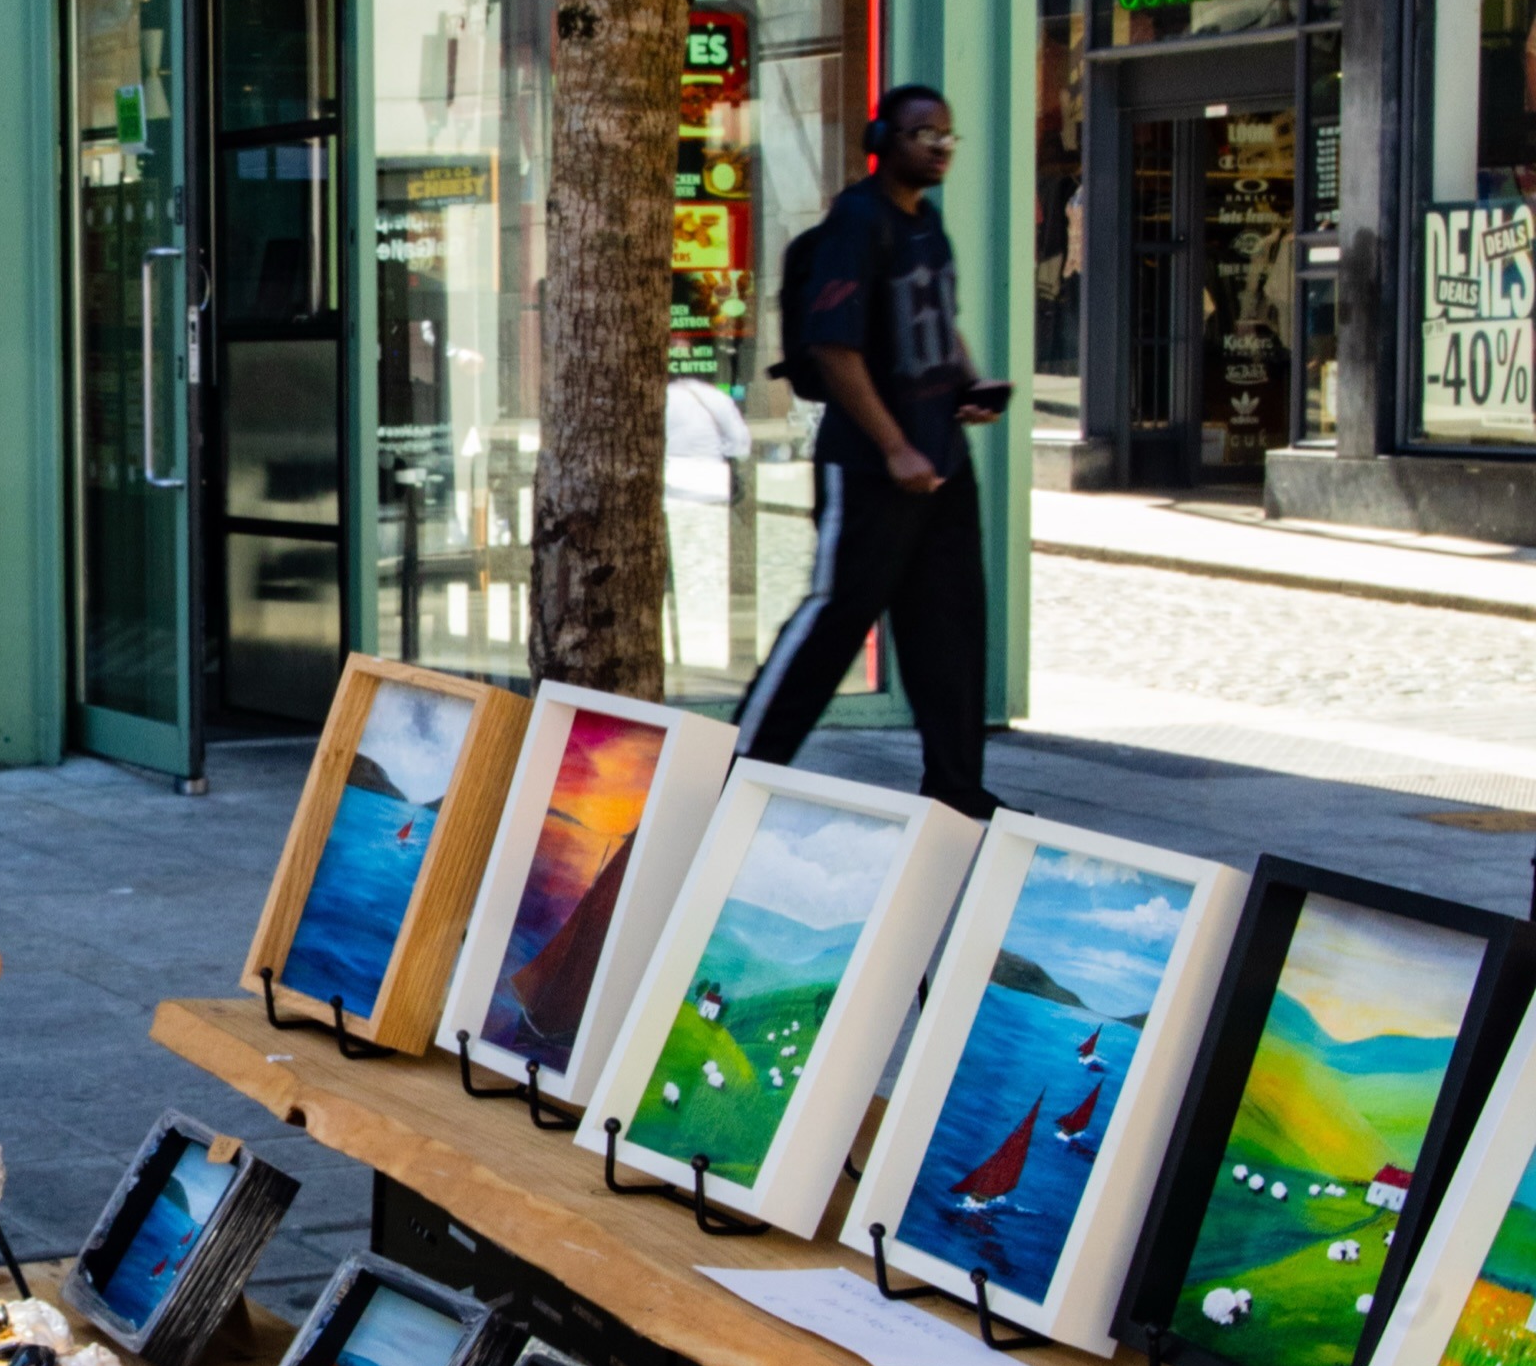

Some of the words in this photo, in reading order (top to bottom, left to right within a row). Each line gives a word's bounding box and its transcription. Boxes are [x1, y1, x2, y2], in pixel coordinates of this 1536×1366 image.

[685, 33, 728, 65] ES
[1485, 223, 1528, 257] DEALS
[1438, 280, 1480, 306] DEALS
[1427, 327, 1529, 407] -40%
